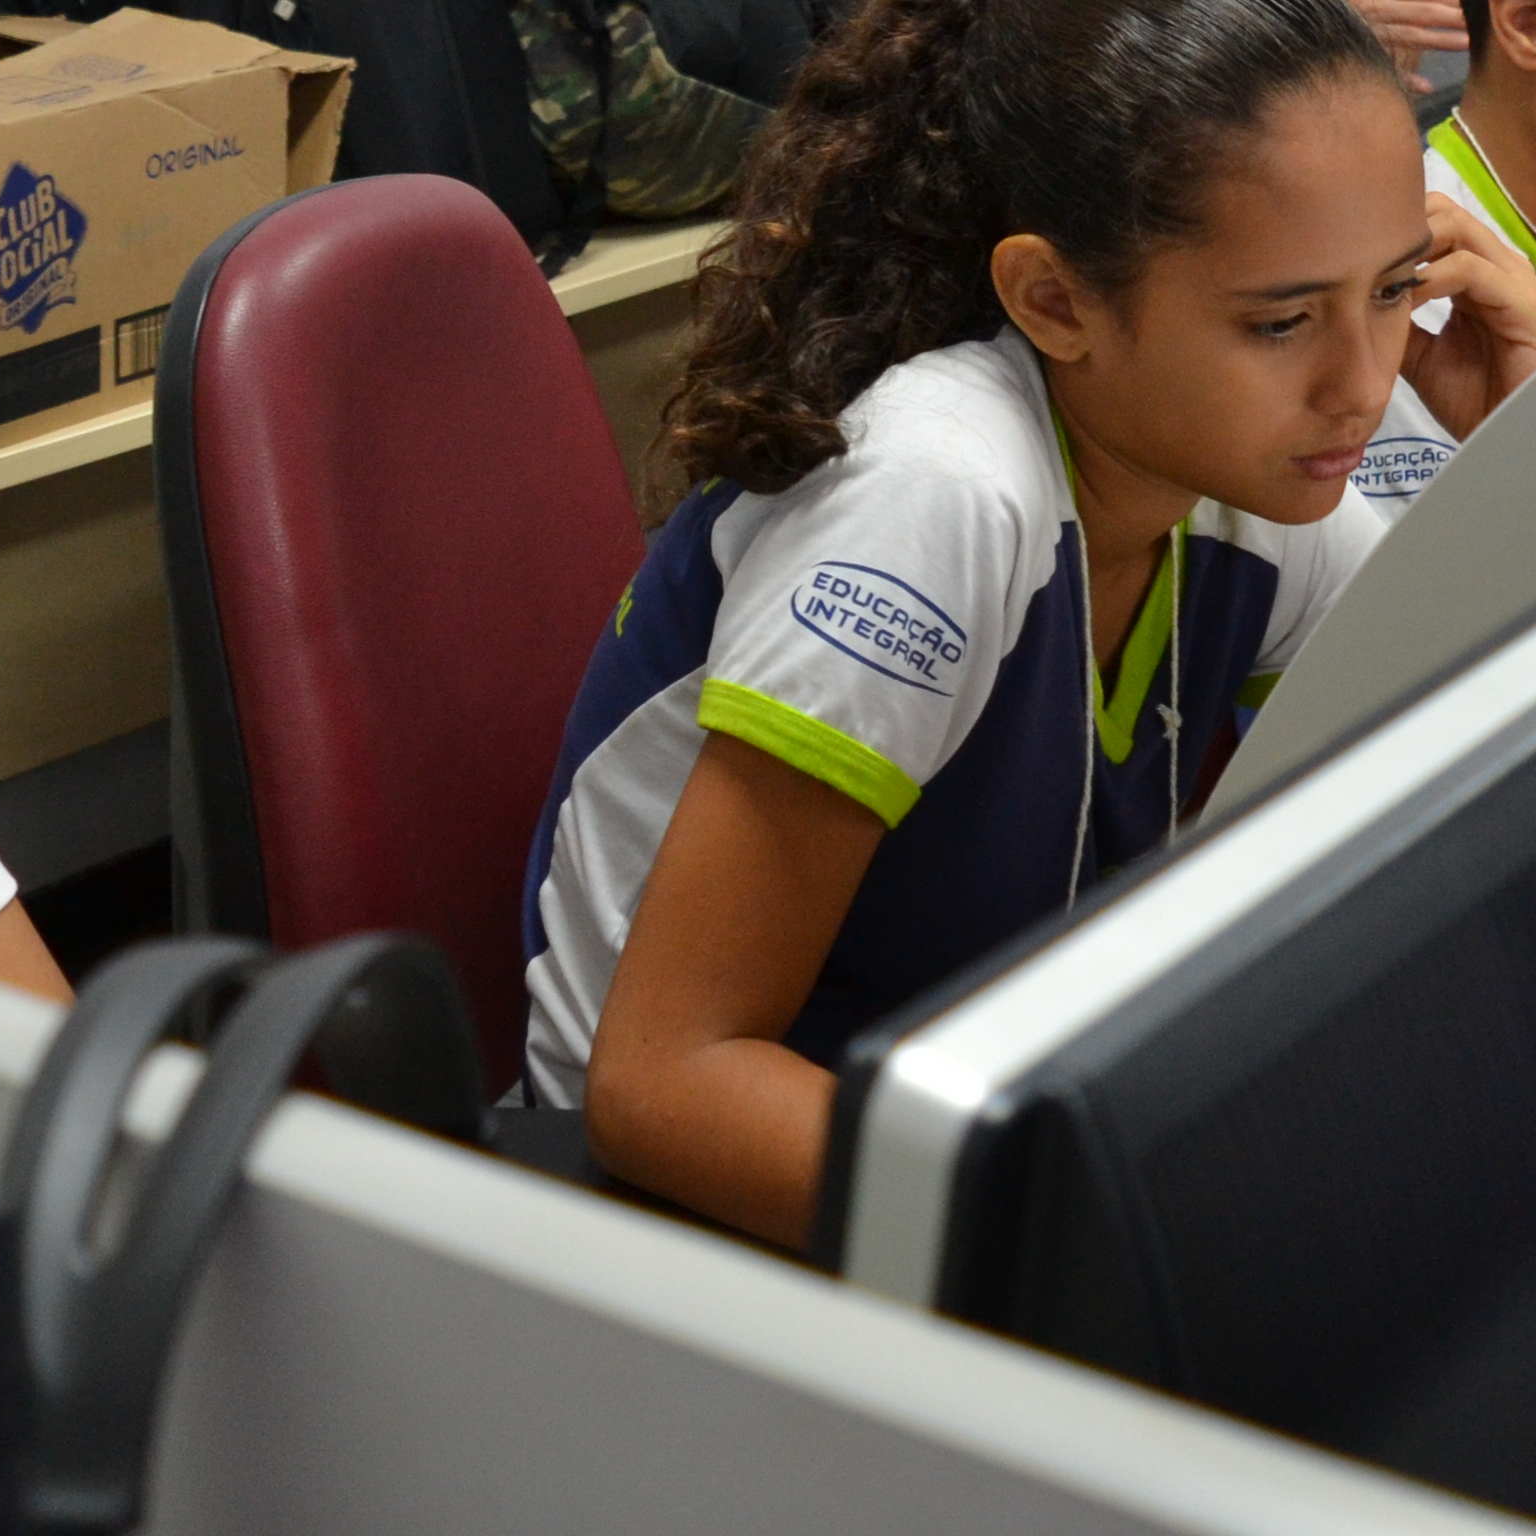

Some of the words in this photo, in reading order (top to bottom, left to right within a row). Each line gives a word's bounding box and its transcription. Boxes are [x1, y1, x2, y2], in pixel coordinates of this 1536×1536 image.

[145, 135, 244, 179] ORIGINAL
[1359, 448, 1450, 470] DUCAÇÃO
[804, 596, 939, 681] INTEGRAL
[812, 571, 962, 664] EDUCAÇÃO
